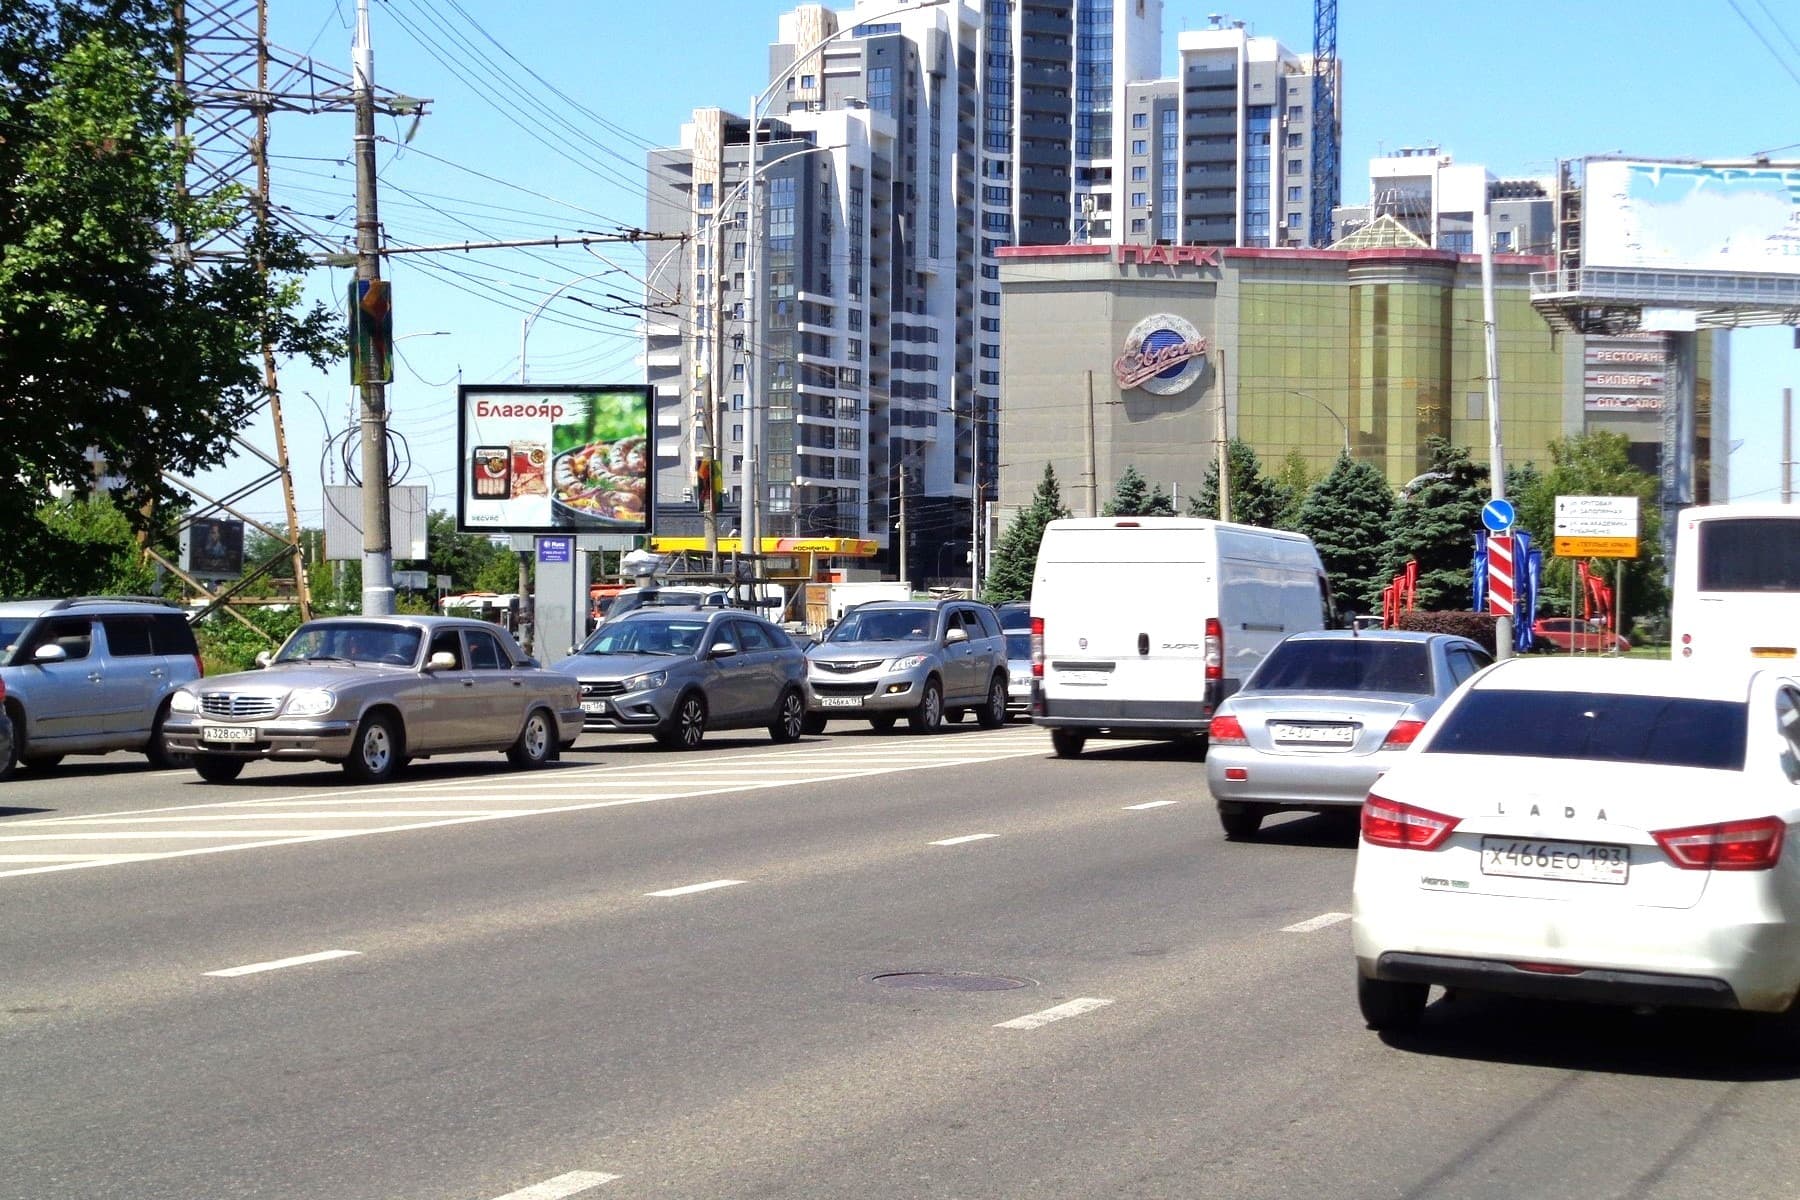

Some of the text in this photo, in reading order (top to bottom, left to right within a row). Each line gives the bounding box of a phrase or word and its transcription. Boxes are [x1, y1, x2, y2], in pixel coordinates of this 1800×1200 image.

[1118, 244, 1218, 266] ПАРК
[1597, 375, 1652, 386] БИЛЬЯРД
[476, 400, 563, 423] Благояр
[1498, 802, 1607, 821] LADA
